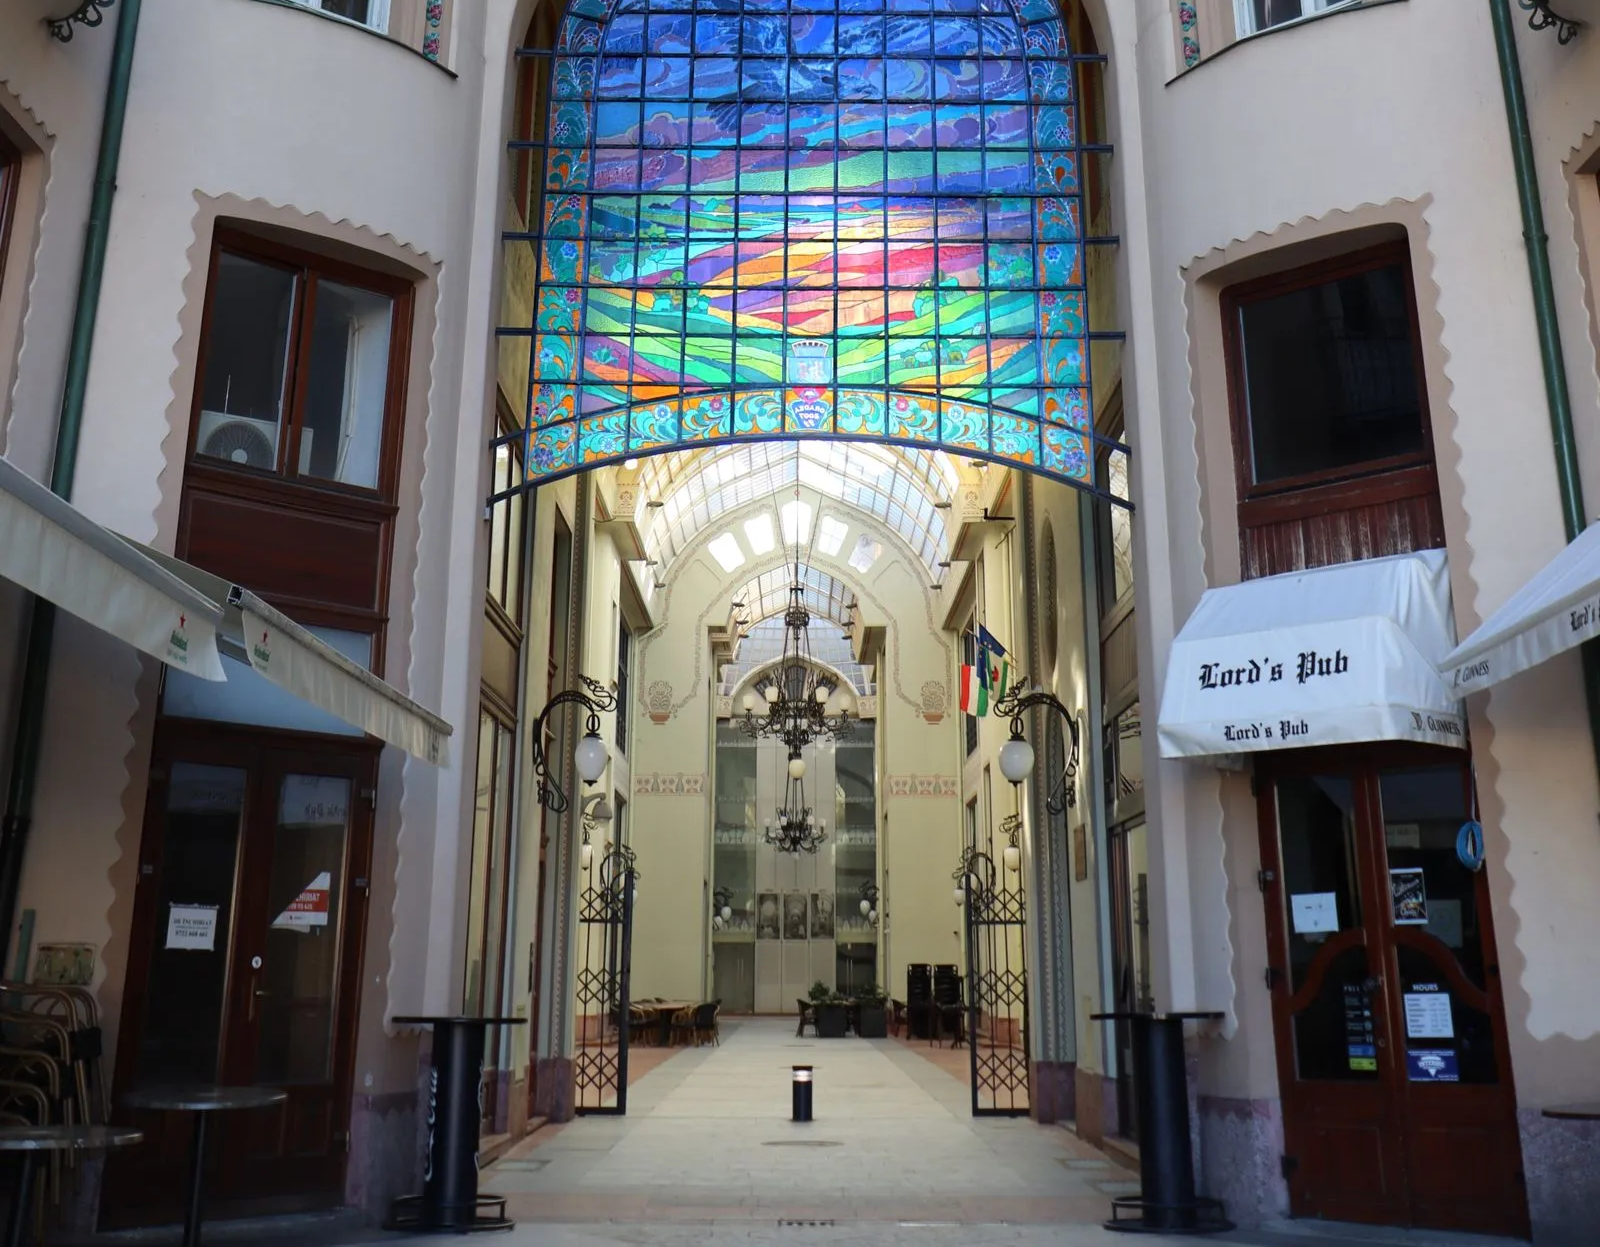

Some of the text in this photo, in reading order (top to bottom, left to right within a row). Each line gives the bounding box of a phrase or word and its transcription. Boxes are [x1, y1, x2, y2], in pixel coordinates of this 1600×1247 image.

[1199, 648, 1349, 690] Lord's Pub
[1462, 659, 1490, 684] GUINNESS
[1224, 719, 1309, 742] Lord's Pub
[1427, 715, 1461, 736] GUINNESS
[1412, 983, 1439, 992] HOURS
